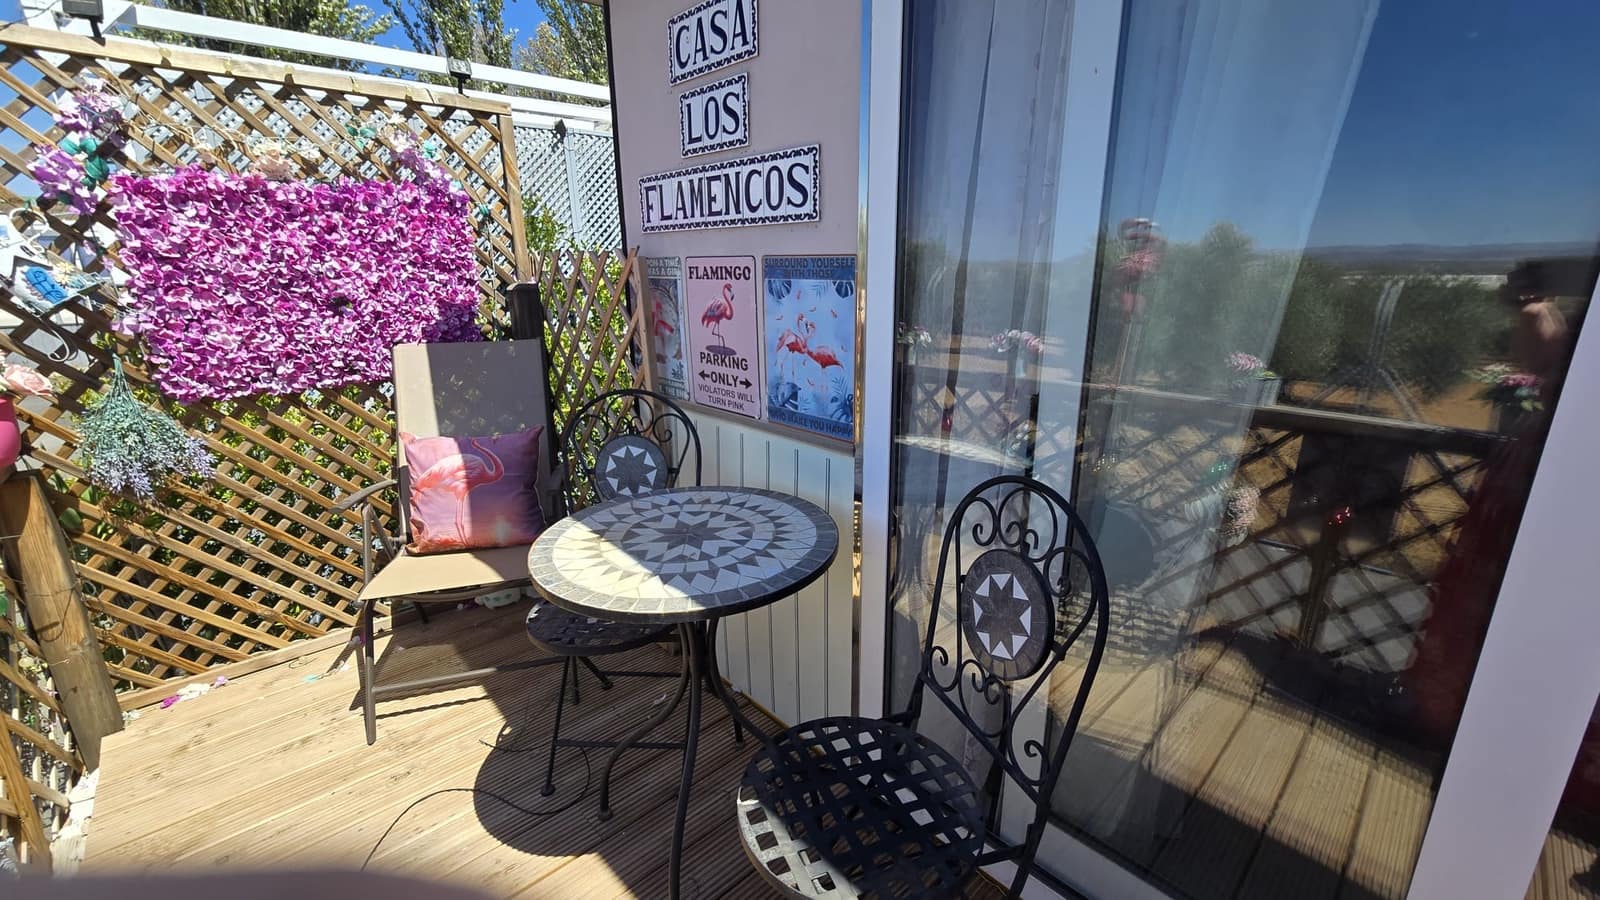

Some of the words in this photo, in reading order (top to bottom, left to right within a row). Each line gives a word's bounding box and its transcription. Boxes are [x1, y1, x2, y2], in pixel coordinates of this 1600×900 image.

[675, 0, 750, 69] CASA
[686, 91, 740, 145] LOS
[643, 162, 810, 223] FLAMENCOS
[764, 257, 808, 268] SURROUND
[812, 256, 855, 268] YOURSELF
[688, 266, 751, 280] FLAMINGO
[700, 352, 748, 371] PARKING
[711, 371, 739, 387] ONLY
[698, 384, 735, 399] VIOLATORS
[737, 392, 755, 403] WILL
[708, 395, 727, 407] TURN
[728, 400, 745, 411] PINK
